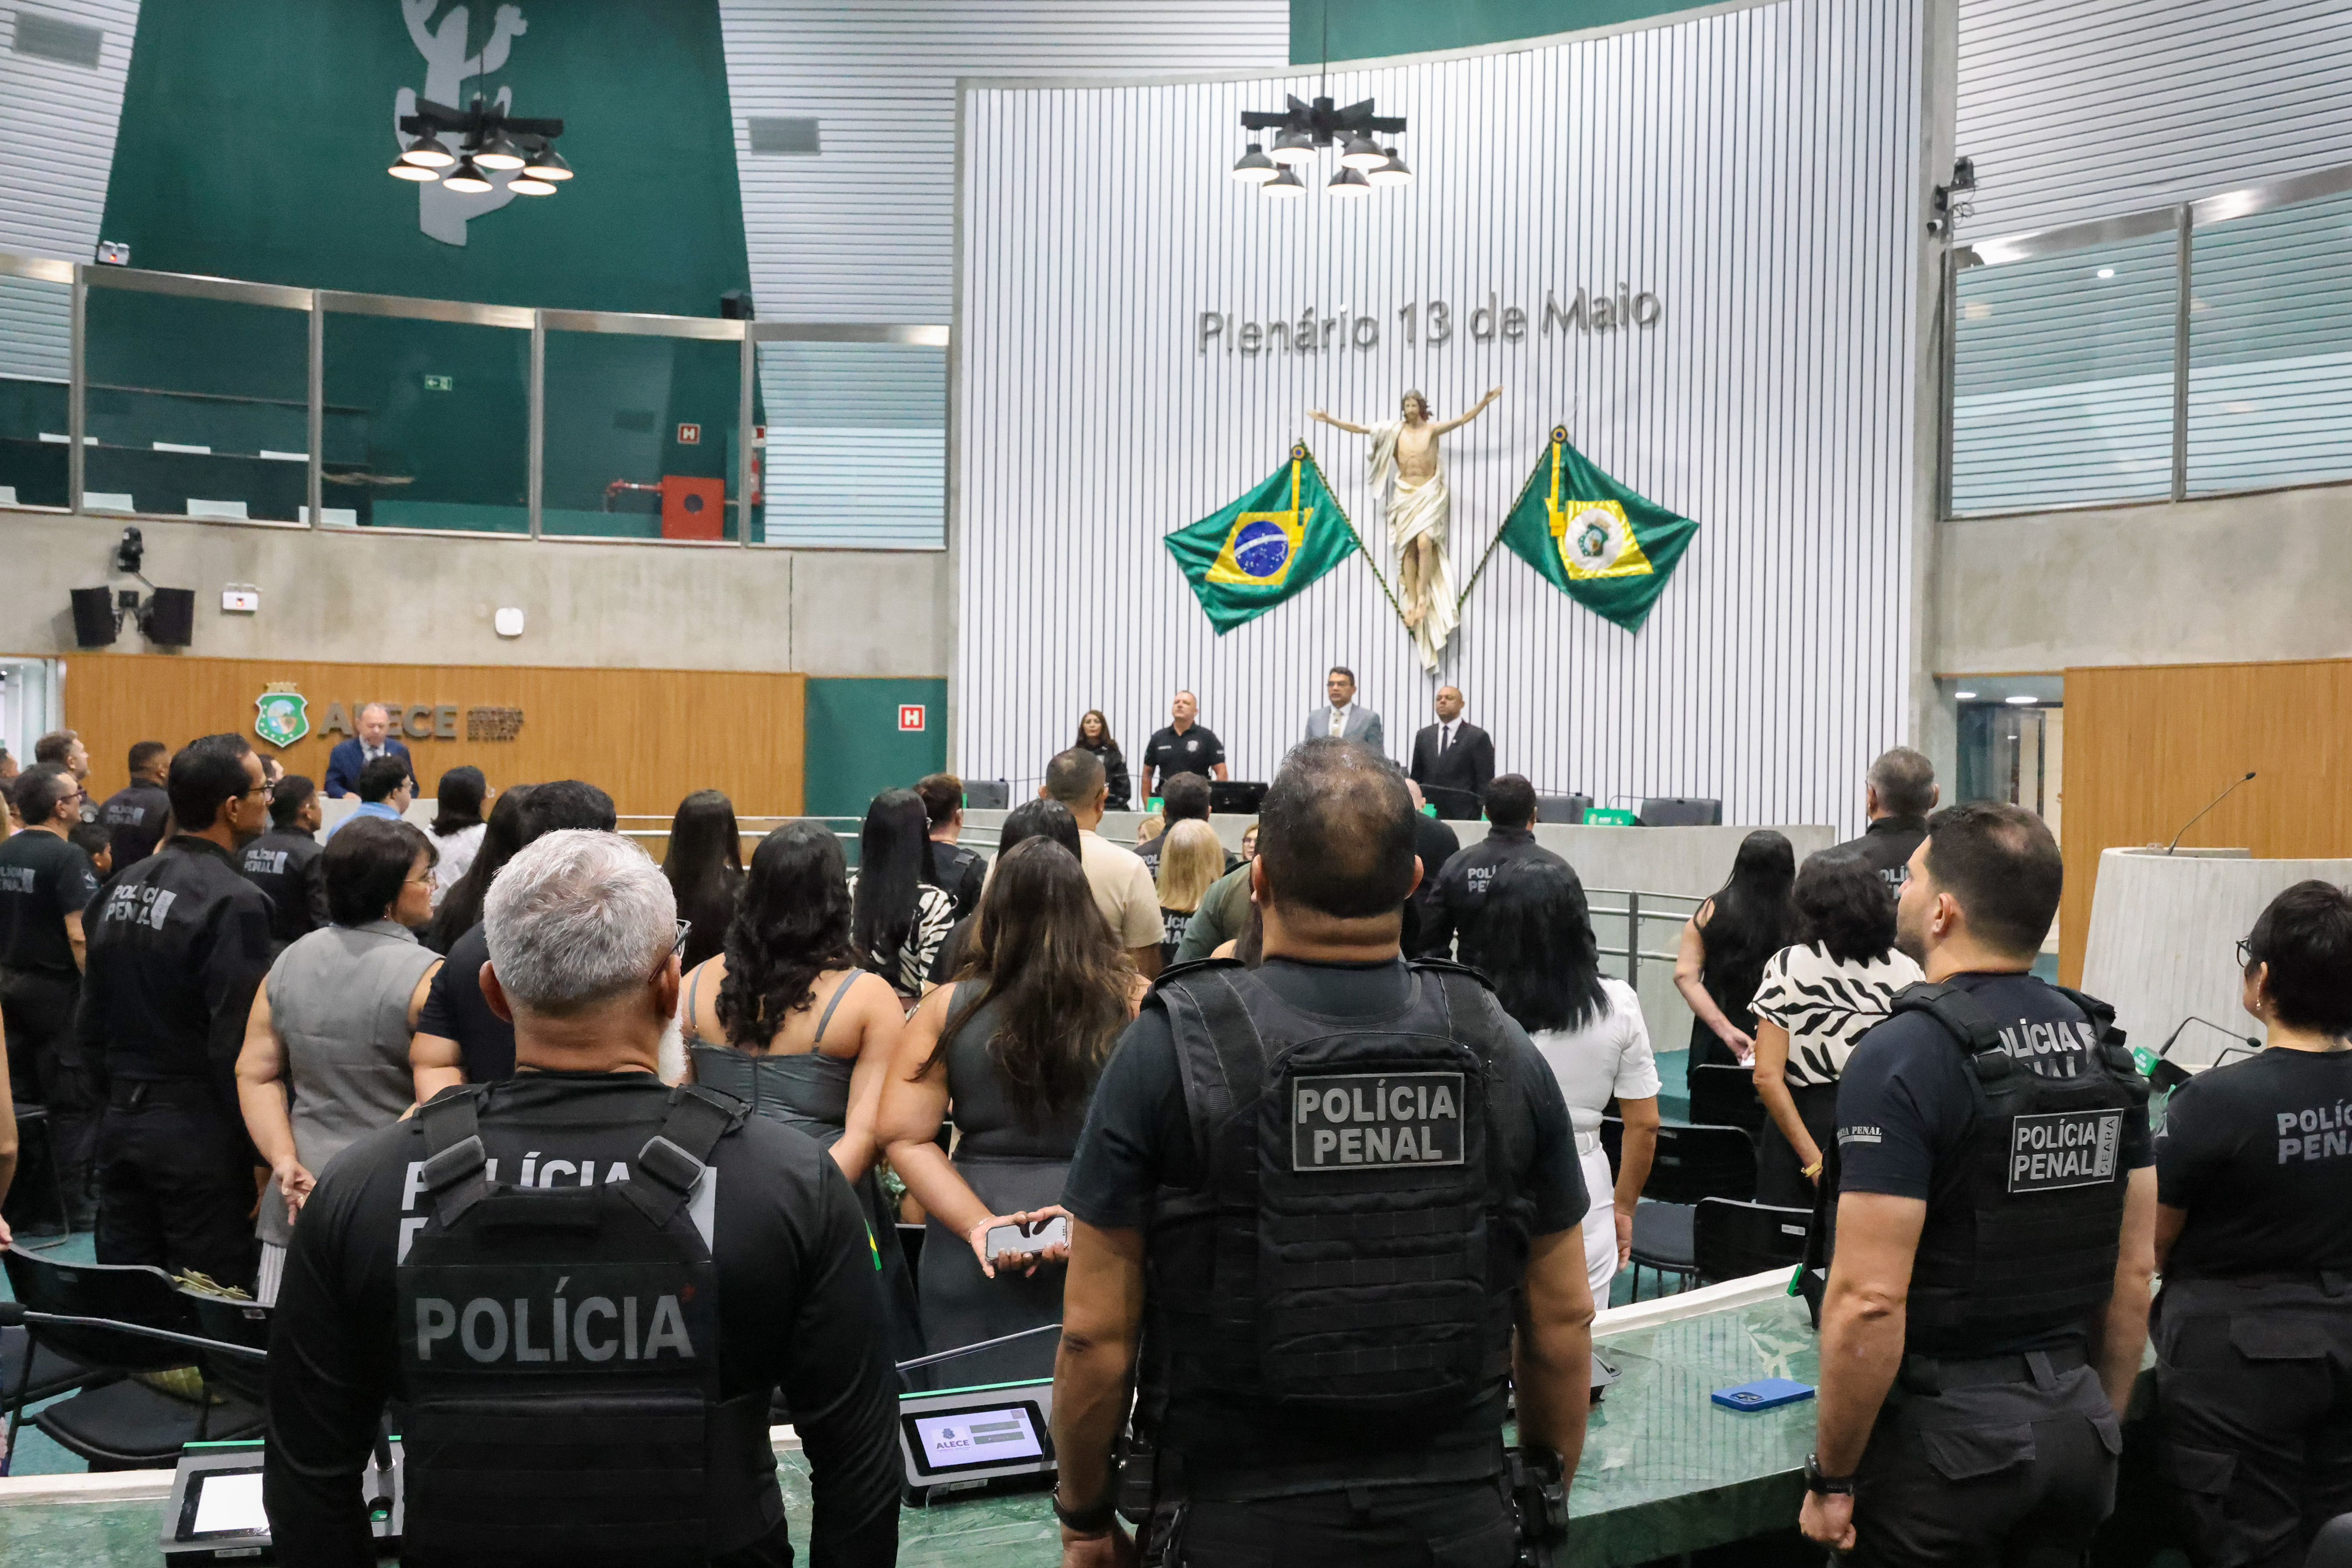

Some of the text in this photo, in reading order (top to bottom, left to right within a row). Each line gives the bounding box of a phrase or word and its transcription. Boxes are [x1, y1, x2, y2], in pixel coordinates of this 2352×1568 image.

[1199, 282, 1661, 354] Plenário 13 de Maio
[683, 428, 695, 440] H
[905, 710, 919, 726] H
[112, 881, 159, 903] POLÍCI
[1972, 1018, 2082, 1062] OLÍCIA
[1298, 1079, 1457, 1124] POLÍCIA
[1314, 1126, 1442, 1164] PENAL
[1852, 1126, 1882, 1135] PENAL
[2017, 1119, 2096, 1150] POLÍCIA
[2278, 1130, 2352, 1164] PEN
[2014, 1150, 2093, 1181] PENAL
[416, 1276, 695, 1362] POLÍCIA
[936, 1440, 970, 1449] ALECE
